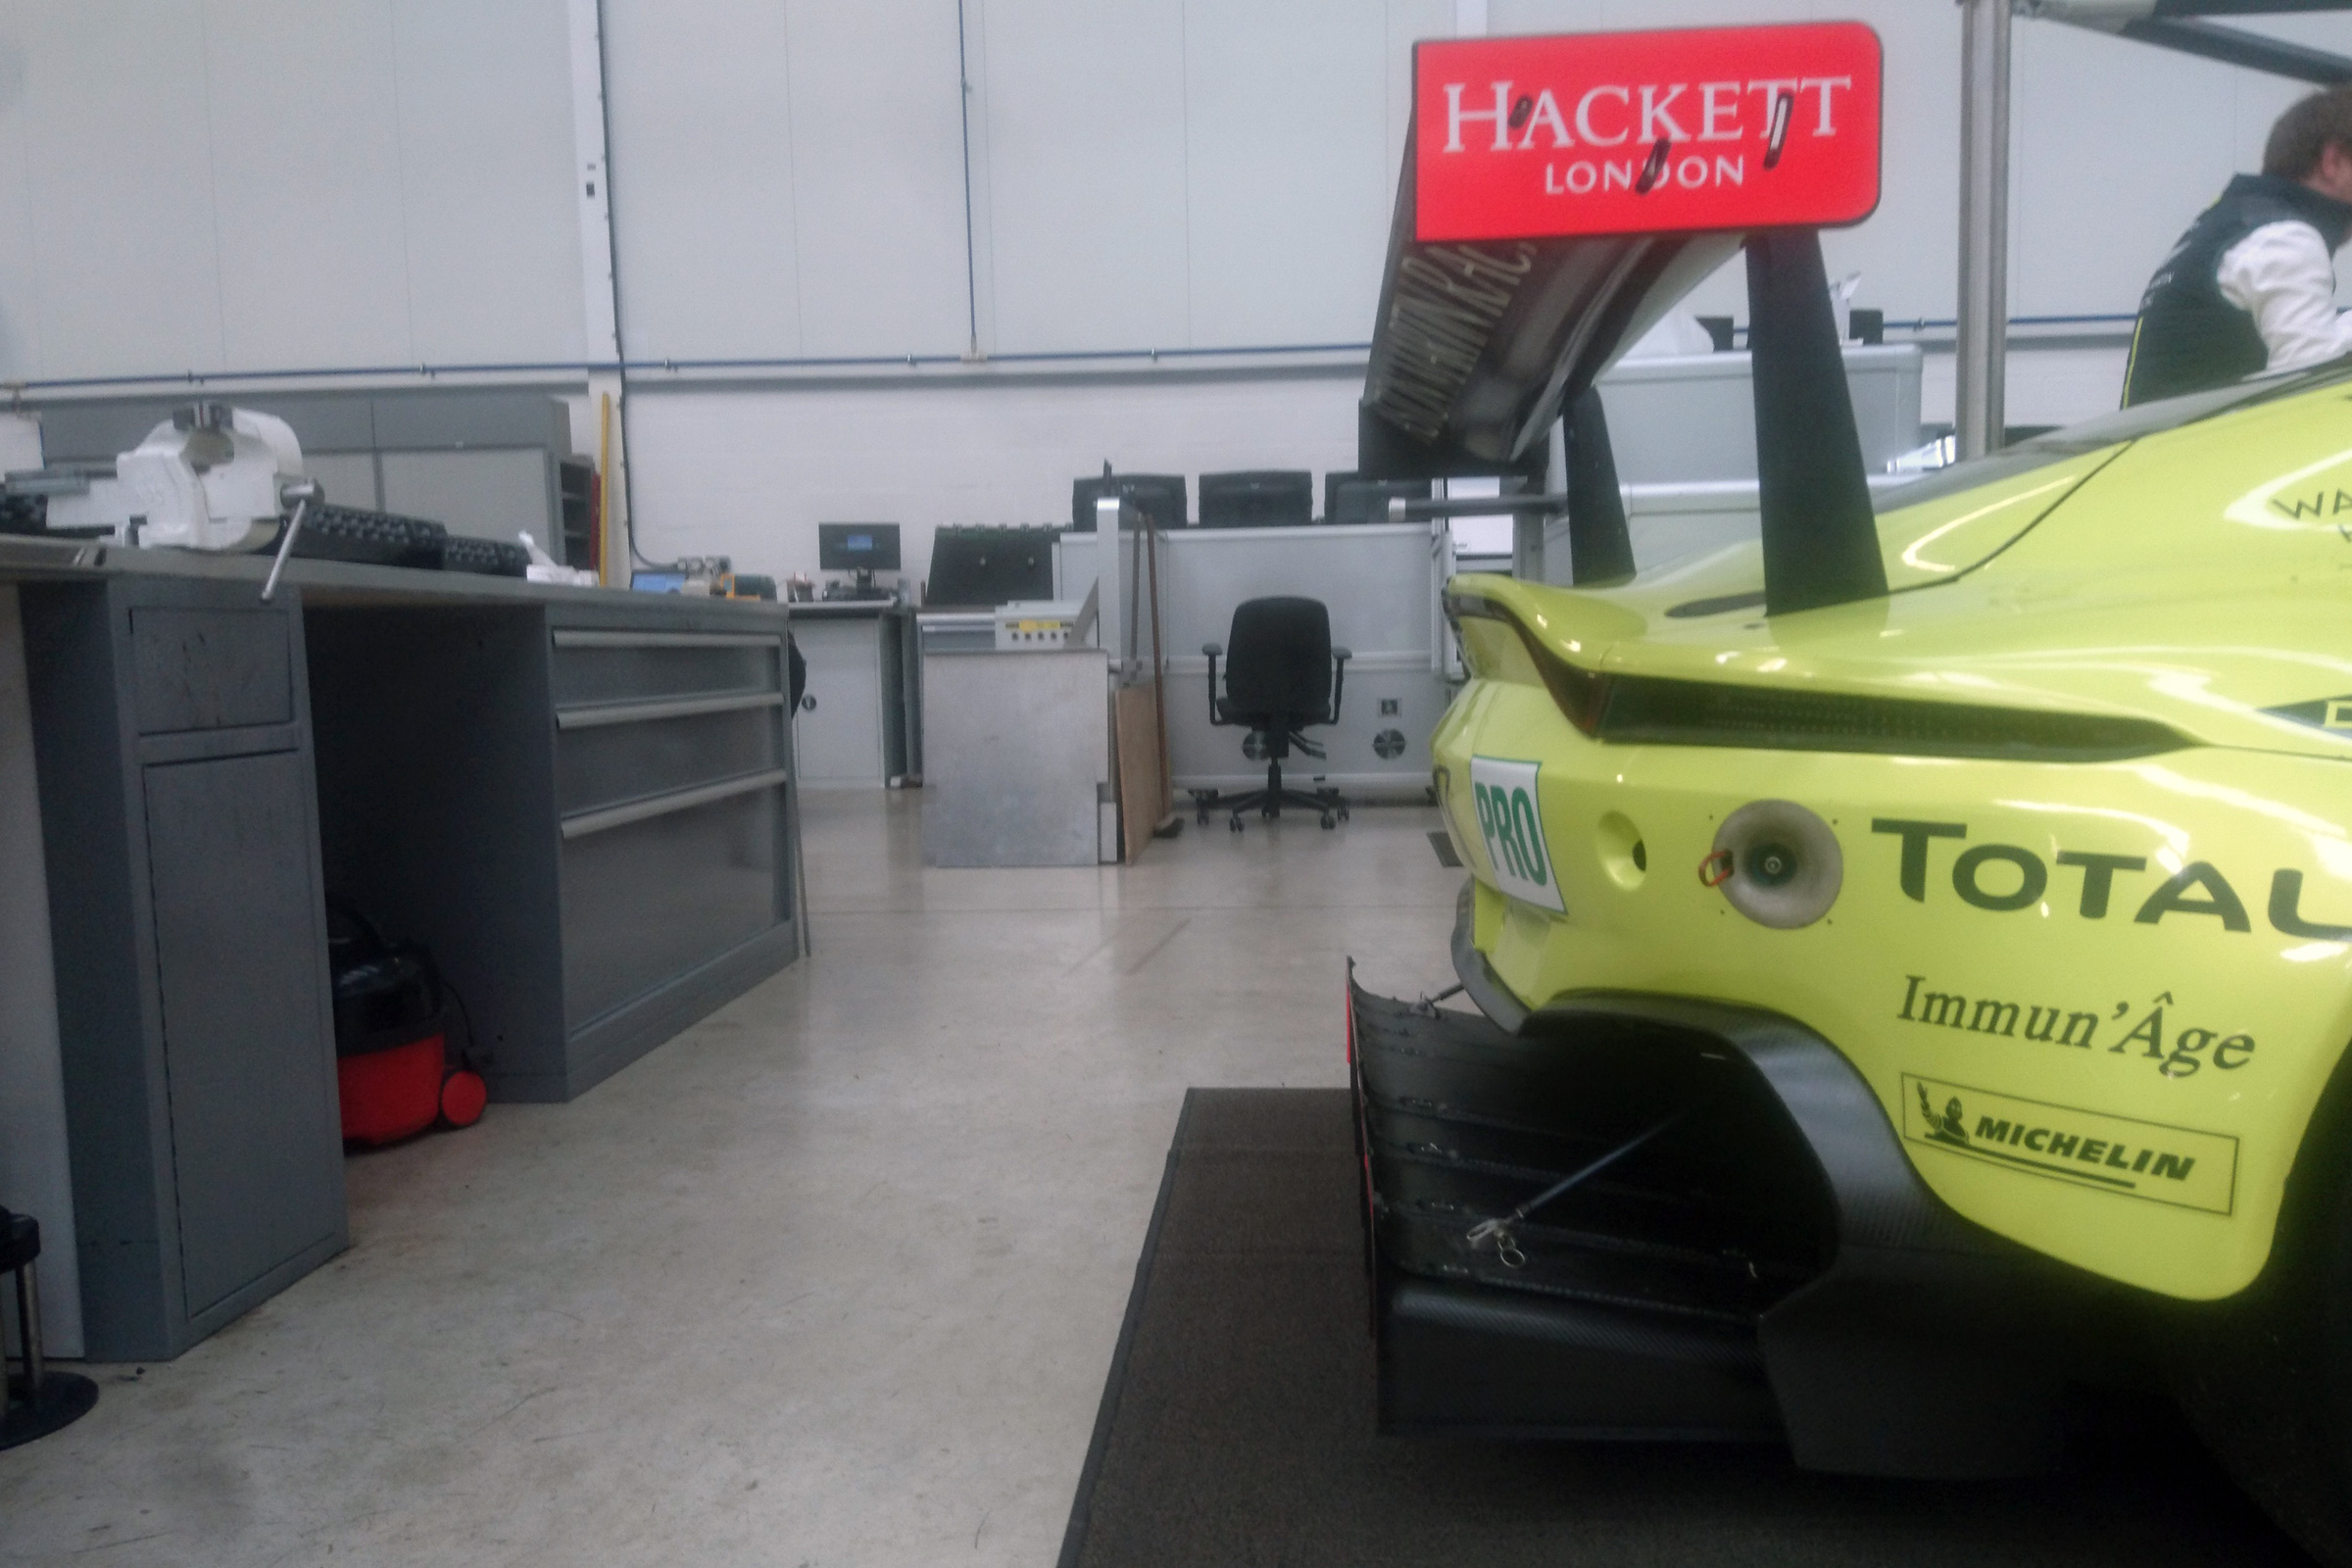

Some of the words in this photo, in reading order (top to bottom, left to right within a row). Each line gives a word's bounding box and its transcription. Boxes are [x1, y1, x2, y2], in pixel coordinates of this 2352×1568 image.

[1445, 76, 1851, 152] HACKETT
[1474, 782, 1547, 887] PRO
[1871, 817, 2352, 943] TOTAL
[1897, 975, 2255, 1078] Immun'Âge
[1975, 1115, 2195, 1182] MICHELIN
